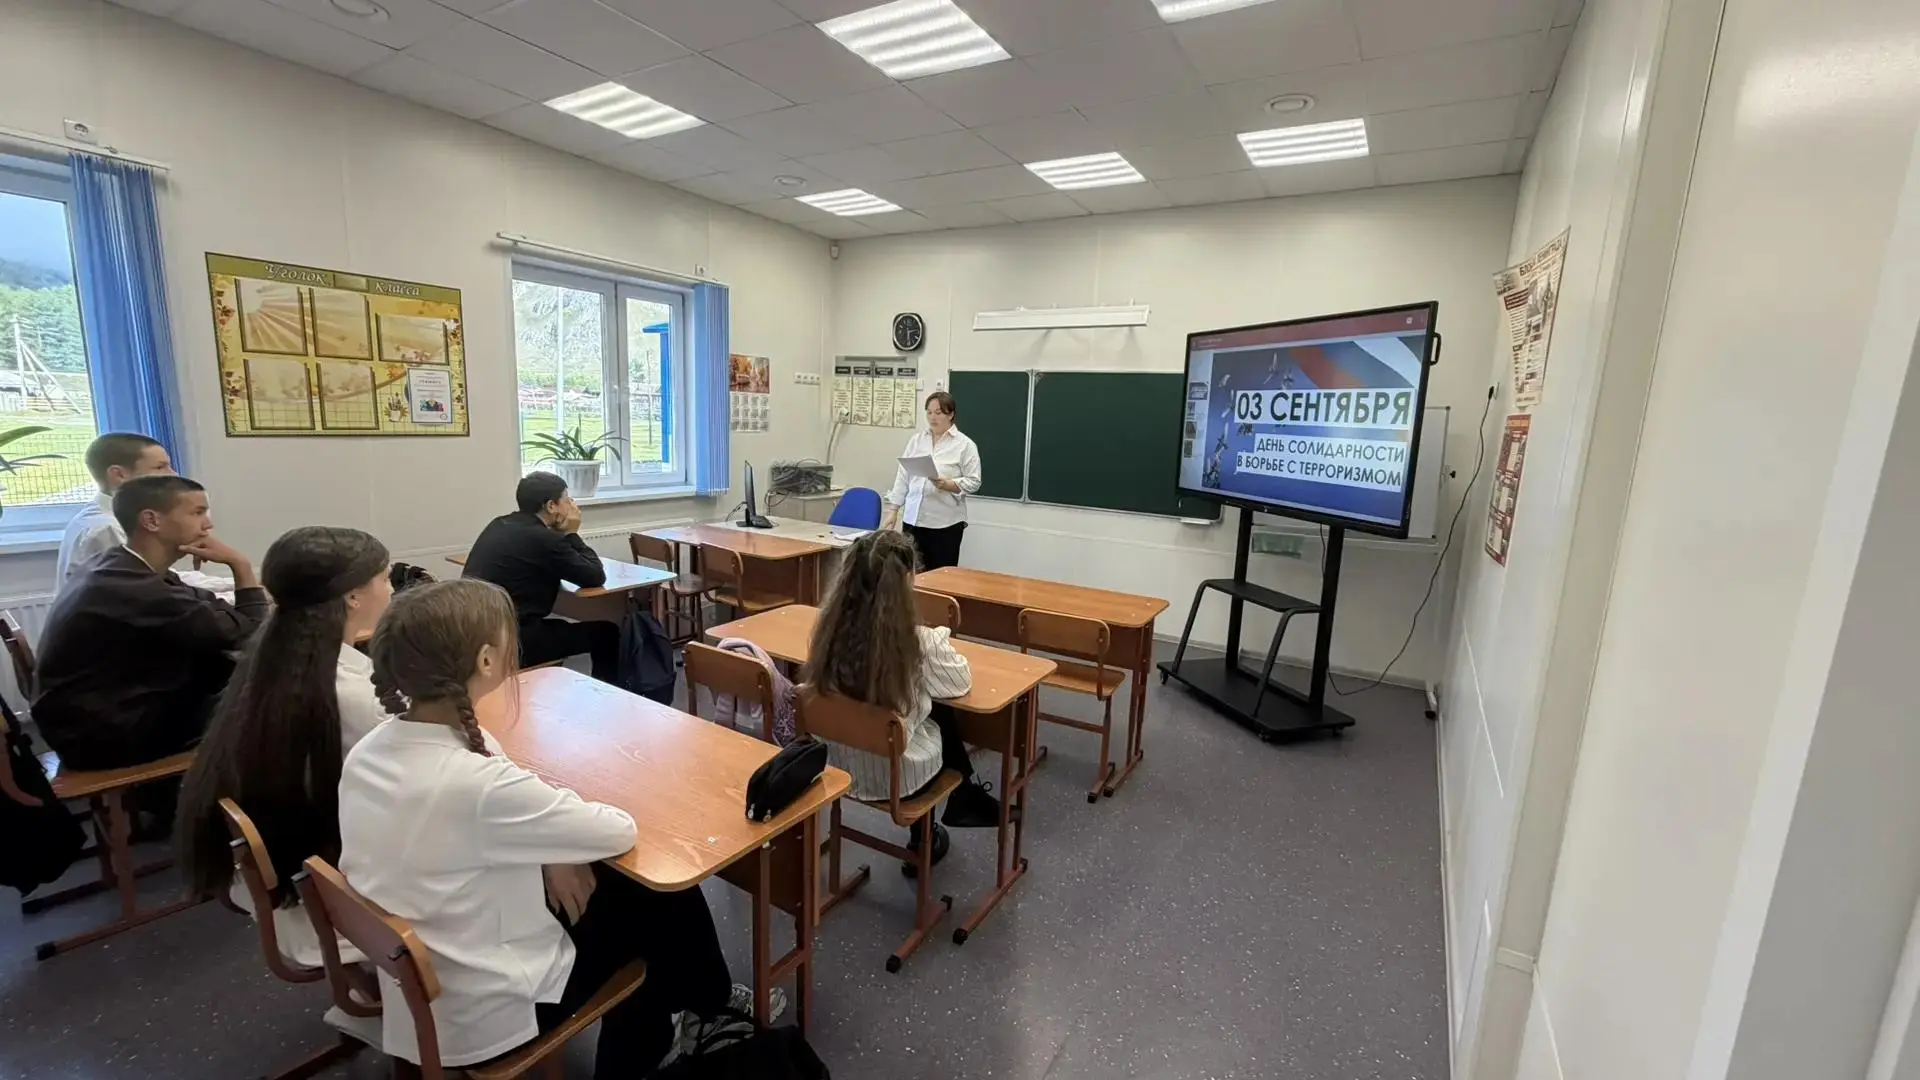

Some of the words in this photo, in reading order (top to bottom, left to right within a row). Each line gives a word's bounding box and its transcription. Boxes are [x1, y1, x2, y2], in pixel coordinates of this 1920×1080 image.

[1238, 392, 1262, 420] 03
[1270, 391, 1412, 425] СЕНТЯБРЯ
[1256, 438, 1285, 452] ДЕНЬ
[1288, 440, 1405, 463] СОЛИДАРНОСТИ
[1237, 455, 1243, 467] В
[1245, 456, 1285, 472] БОРЬБЕ
[1287, 460, 1297, 474] С
[1299, 461, 1402, 487] ТЕРРОРИЗМОМ
